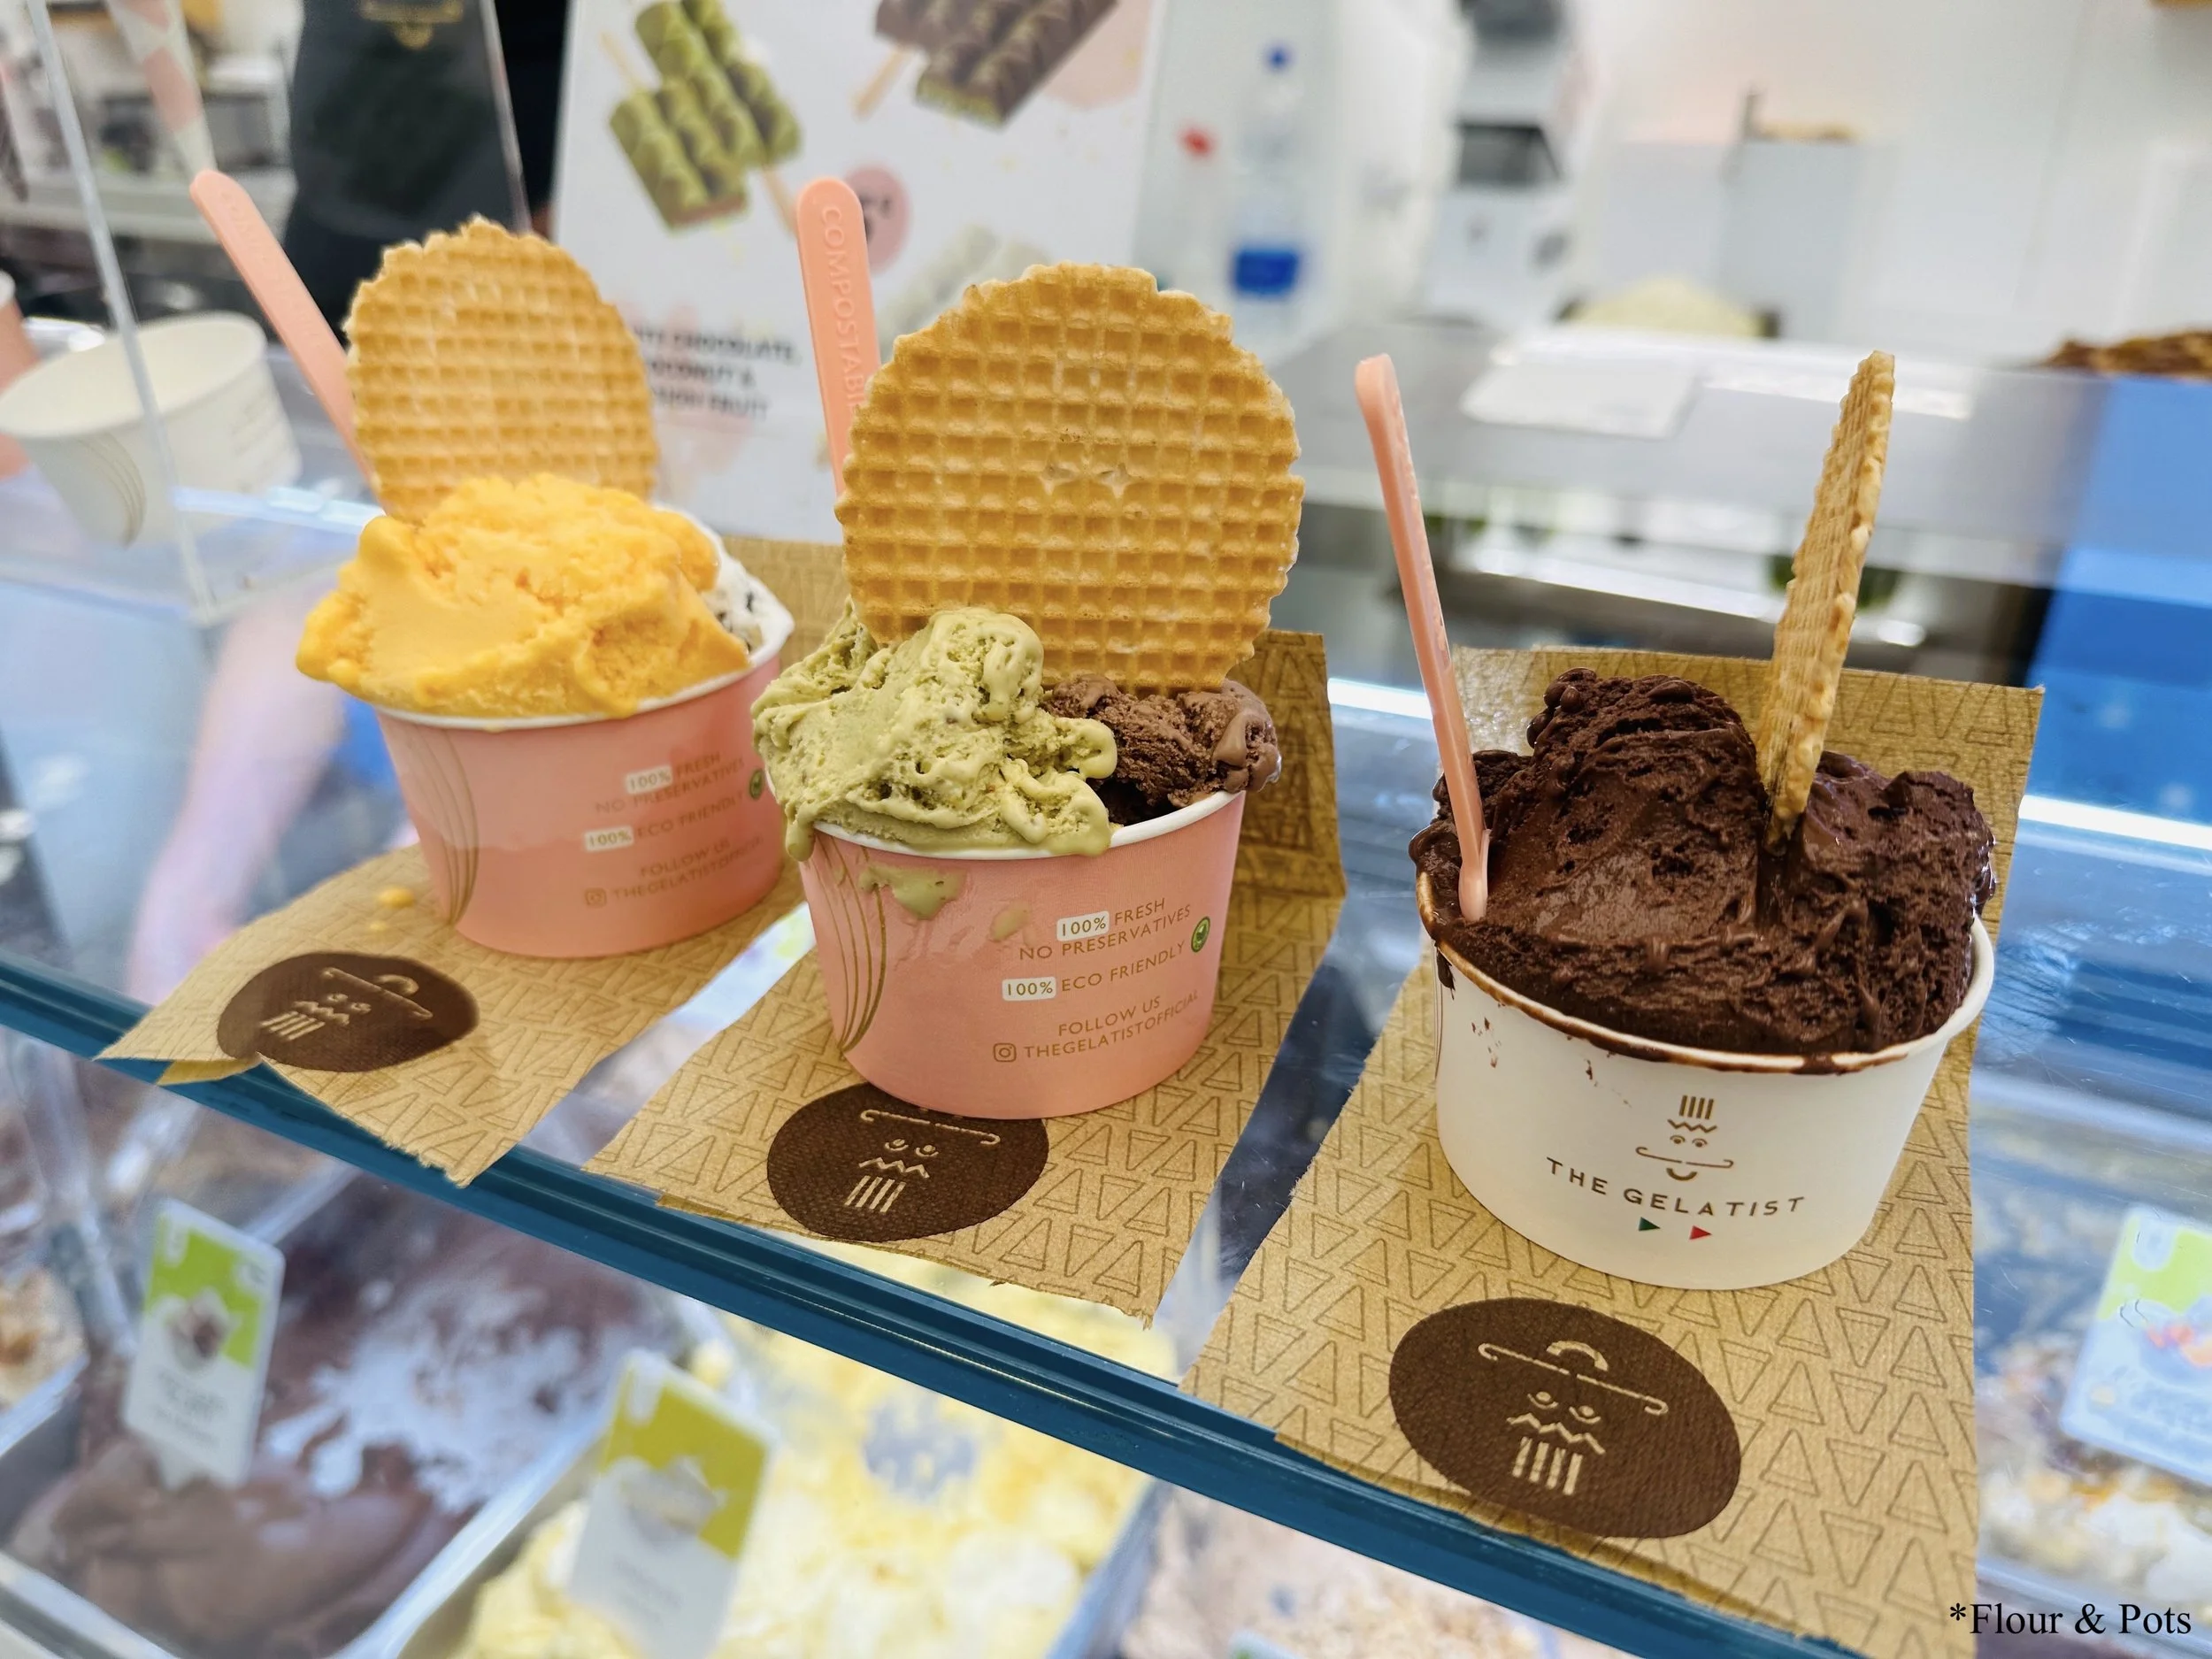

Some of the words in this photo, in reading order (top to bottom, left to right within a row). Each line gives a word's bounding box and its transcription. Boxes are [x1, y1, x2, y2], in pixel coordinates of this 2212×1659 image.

[595, 798, 626, 815] NO
[634, 757, 744, 808] PRESERVATIVES
[628, 769, 672, 791] 100%
[675, 750, 720, 779] FRESH
[588, 829, 632, 847] 100%
[636, 818, 674, 839] ECO
[680, 790, 743, 826] FRIENDLY
[640, 846, 710, 879] FOLLOW
[1019, 945, 1054, 961] NO
[1062, 904, 1191, 956] PRESERVATIVES
[1061, 915, 1107, 937] 100%
[1114, 897, 1165, 926] FRESH
[1007, 979, 1054, 997] 100%
[1062, 972, 1102, 993] ECO
[1110, 940, 1186, 982] FRIENDLY
[1024, 988, 1199, 1059] THEGELATISTOFFICIAL
[1058, 1005, 1137, 1037] FOLLOW
[1142, 995, 1161, 1014] US
[1546, 1156, 1609, 1195] THE
[1623, 1187, 1805, 1217] GELATIST
